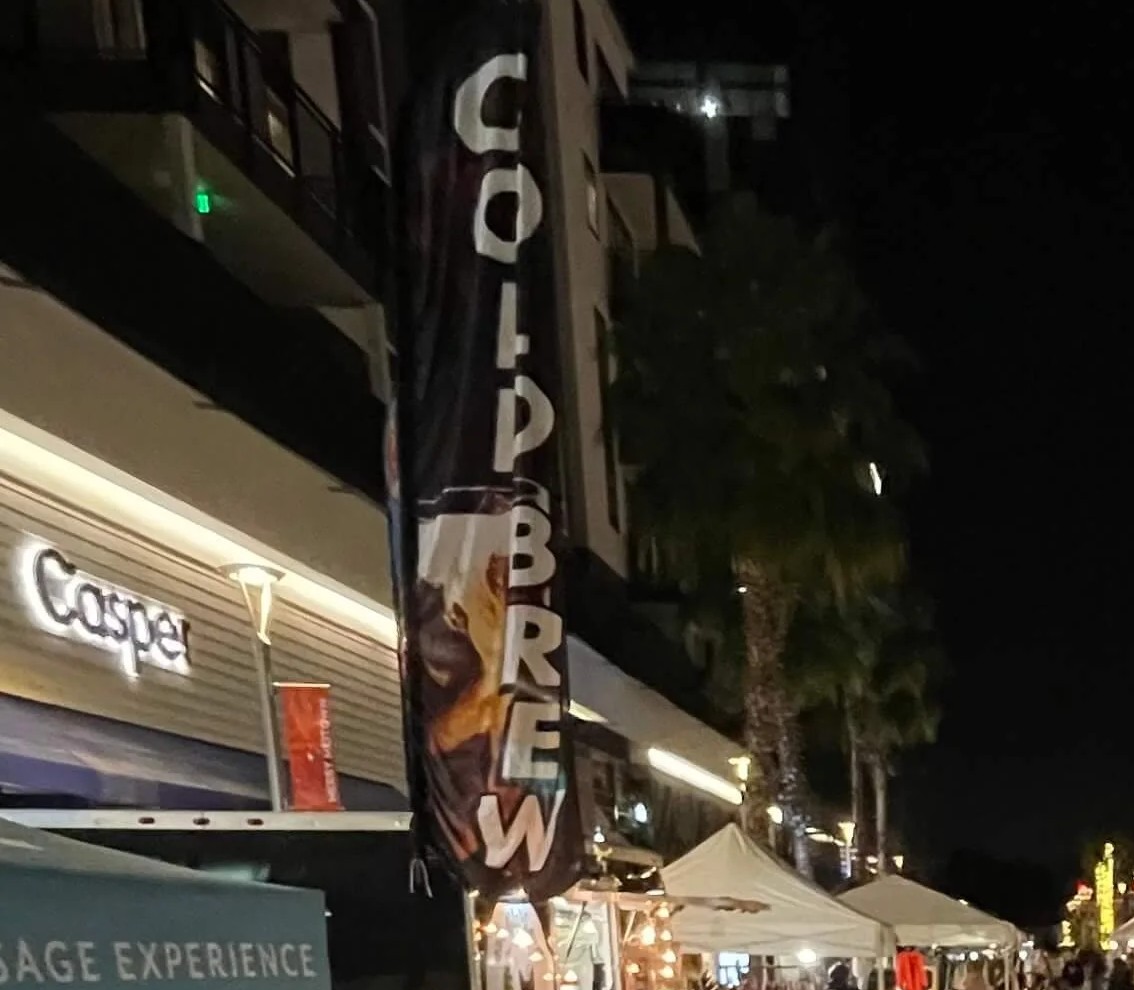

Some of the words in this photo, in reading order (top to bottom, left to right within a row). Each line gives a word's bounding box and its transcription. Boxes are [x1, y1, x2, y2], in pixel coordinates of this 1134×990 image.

[453, 52, 555, 473] COLD
[33, 548, 192, 676] Casper
[478, 504, 565, 872] BREW
[113, 941, 318, 981] EXPERIENCE
